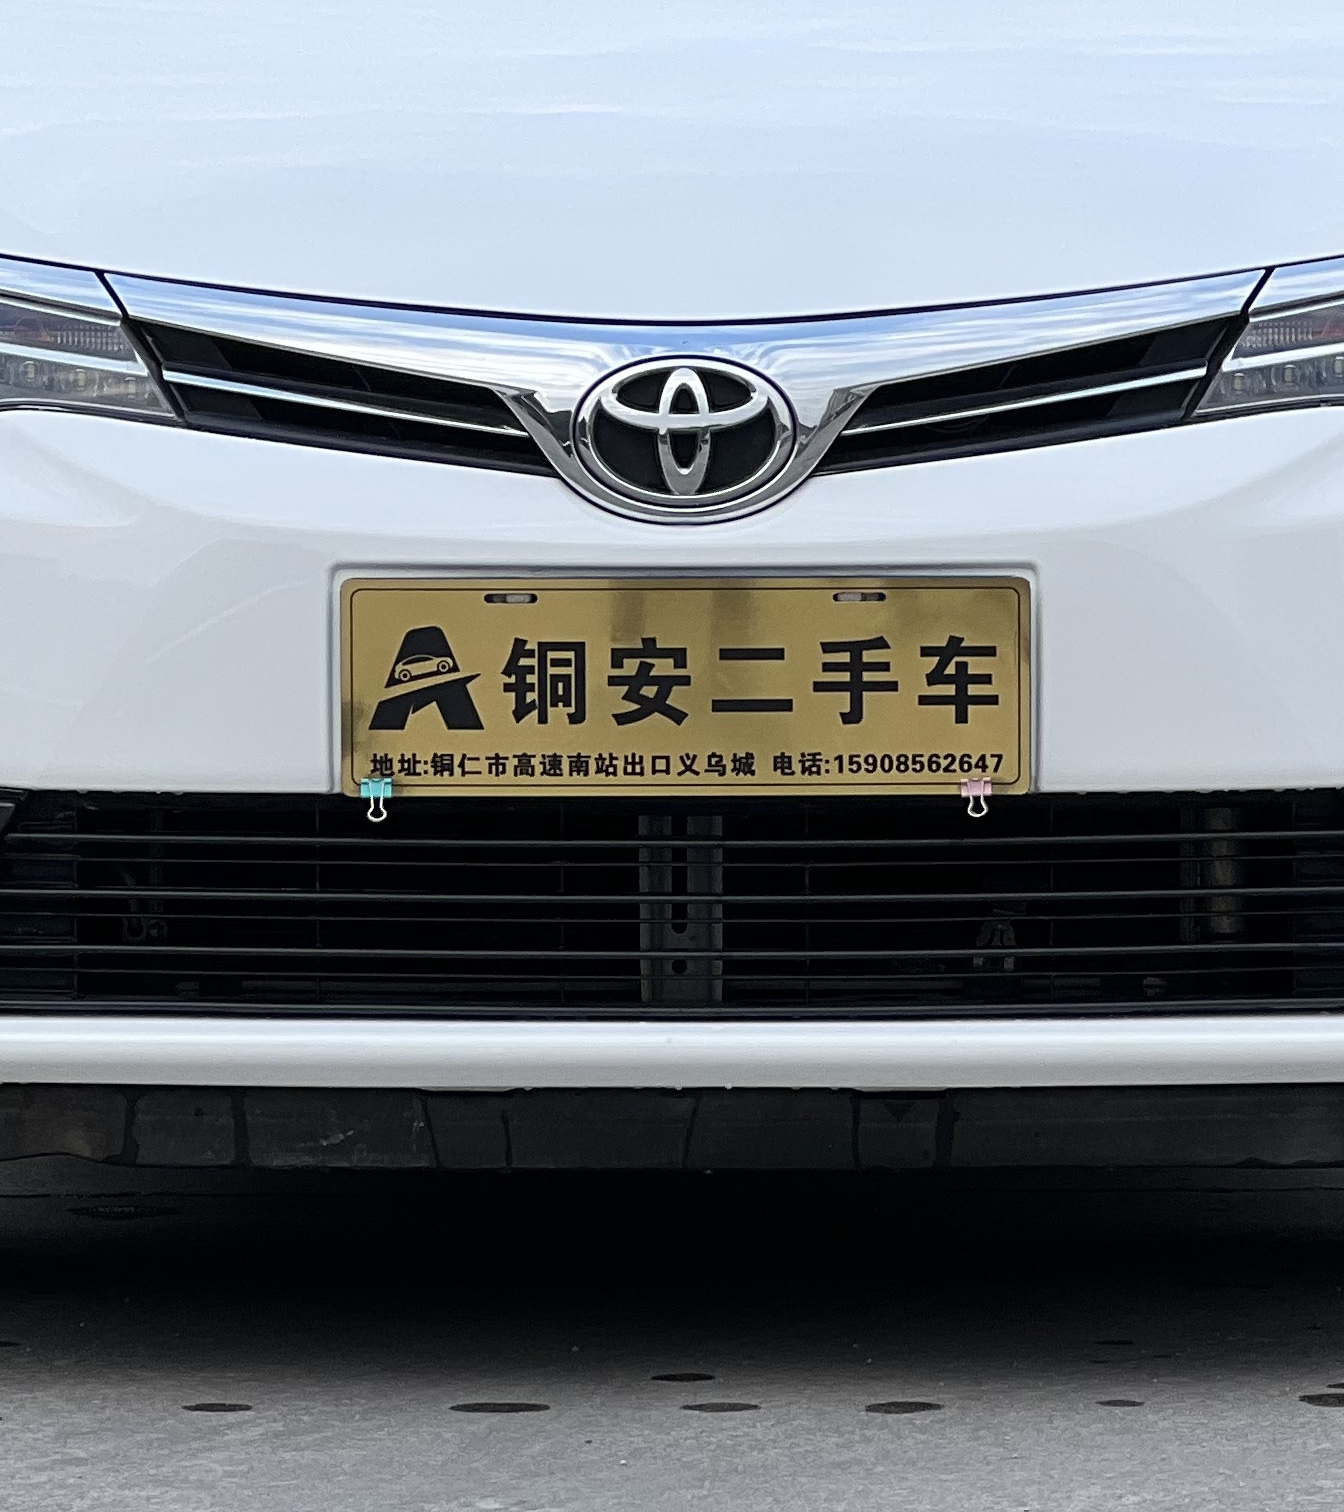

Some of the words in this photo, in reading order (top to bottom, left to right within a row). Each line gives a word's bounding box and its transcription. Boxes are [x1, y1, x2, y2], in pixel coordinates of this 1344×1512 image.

[502, 635, 1001, 726] 铜安二手车
[370, 752, 757, 777] 地址:铜仁市高速南站出口义乌城
[772, 752, 1004, 776] 电话:15908562647
